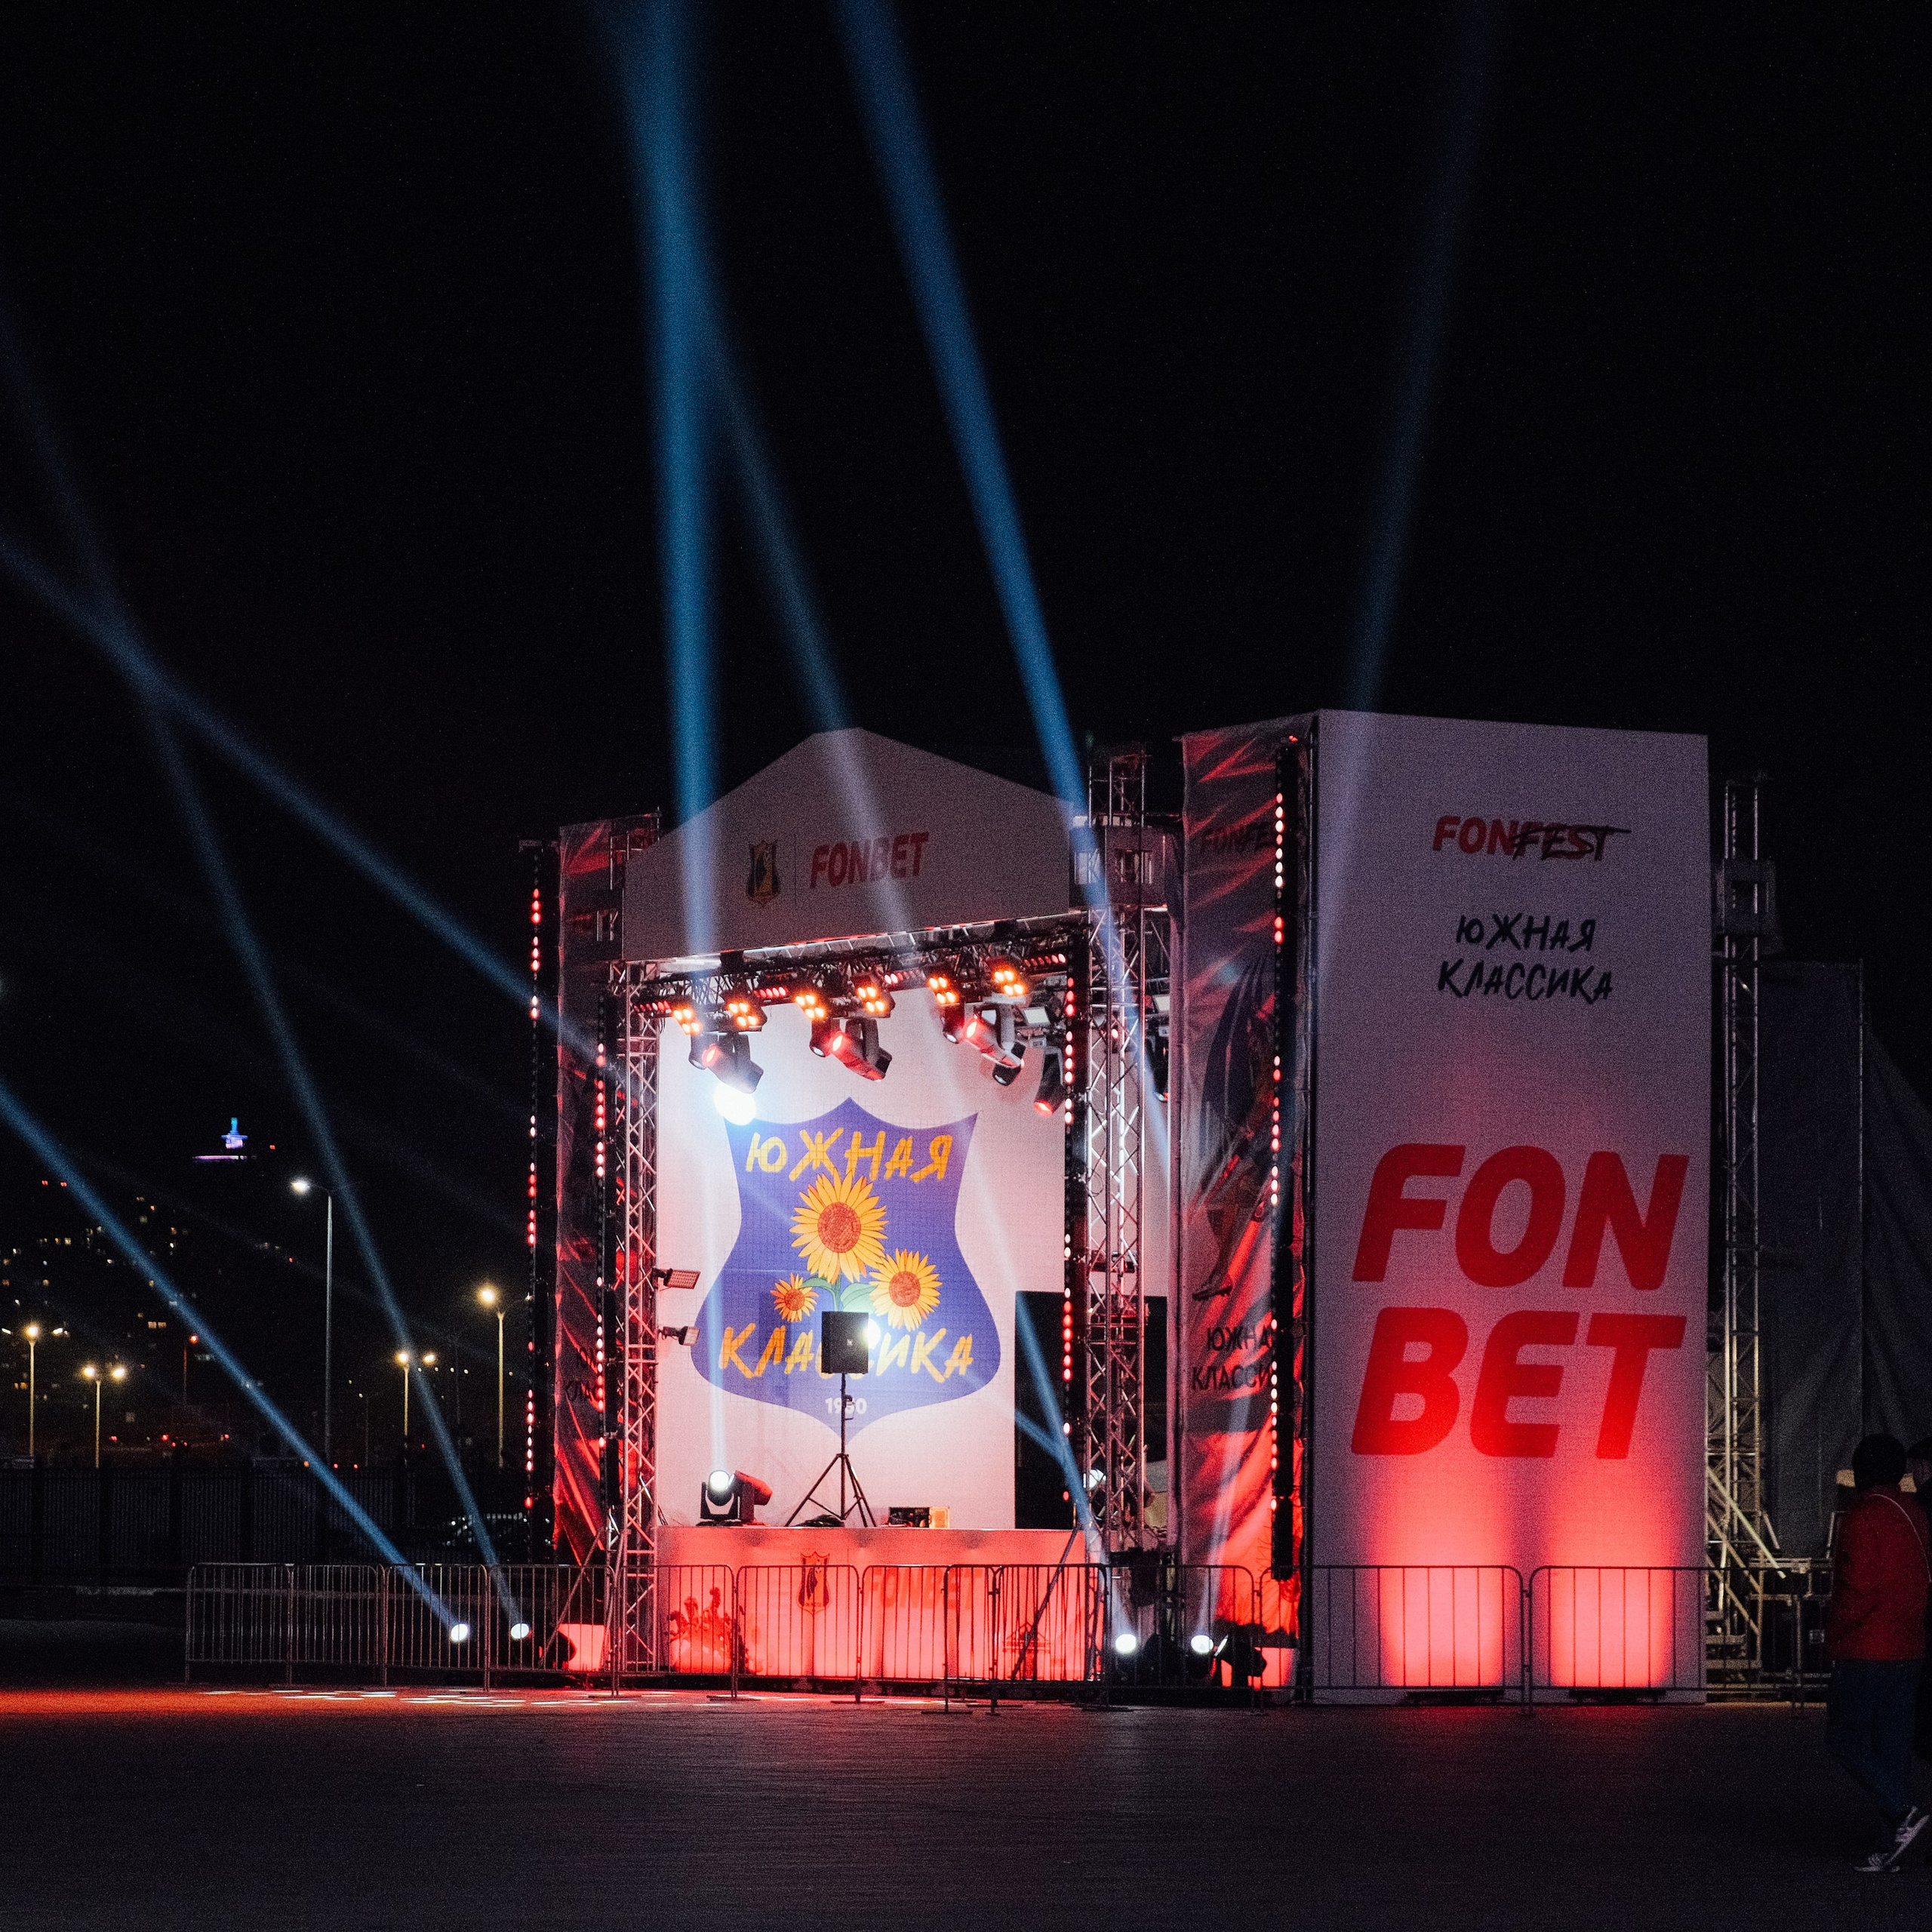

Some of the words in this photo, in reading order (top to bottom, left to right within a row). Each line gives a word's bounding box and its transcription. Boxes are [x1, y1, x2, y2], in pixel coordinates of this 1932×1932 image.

[810, 831, 929, 889] FONBET
[1432, 815, 1632, 862] FONFEST
[1456, 912, 1596, 952] ЮЖНАЯ
[1437, 958, 1613, 1004] КЛАССИКА
[746, 1127, 953, 1183] ЮЖНАЯ
[1352, 1143, 1690, 1291] FON
[718, 1322, 974, 1383] КЛАИКА
[1206, 1326, 1273, 1351] ЮЖНА
[1192, 1364, 1273, 1390] КЛАССИ
[1351, 1306, 1687, 1460] BET
